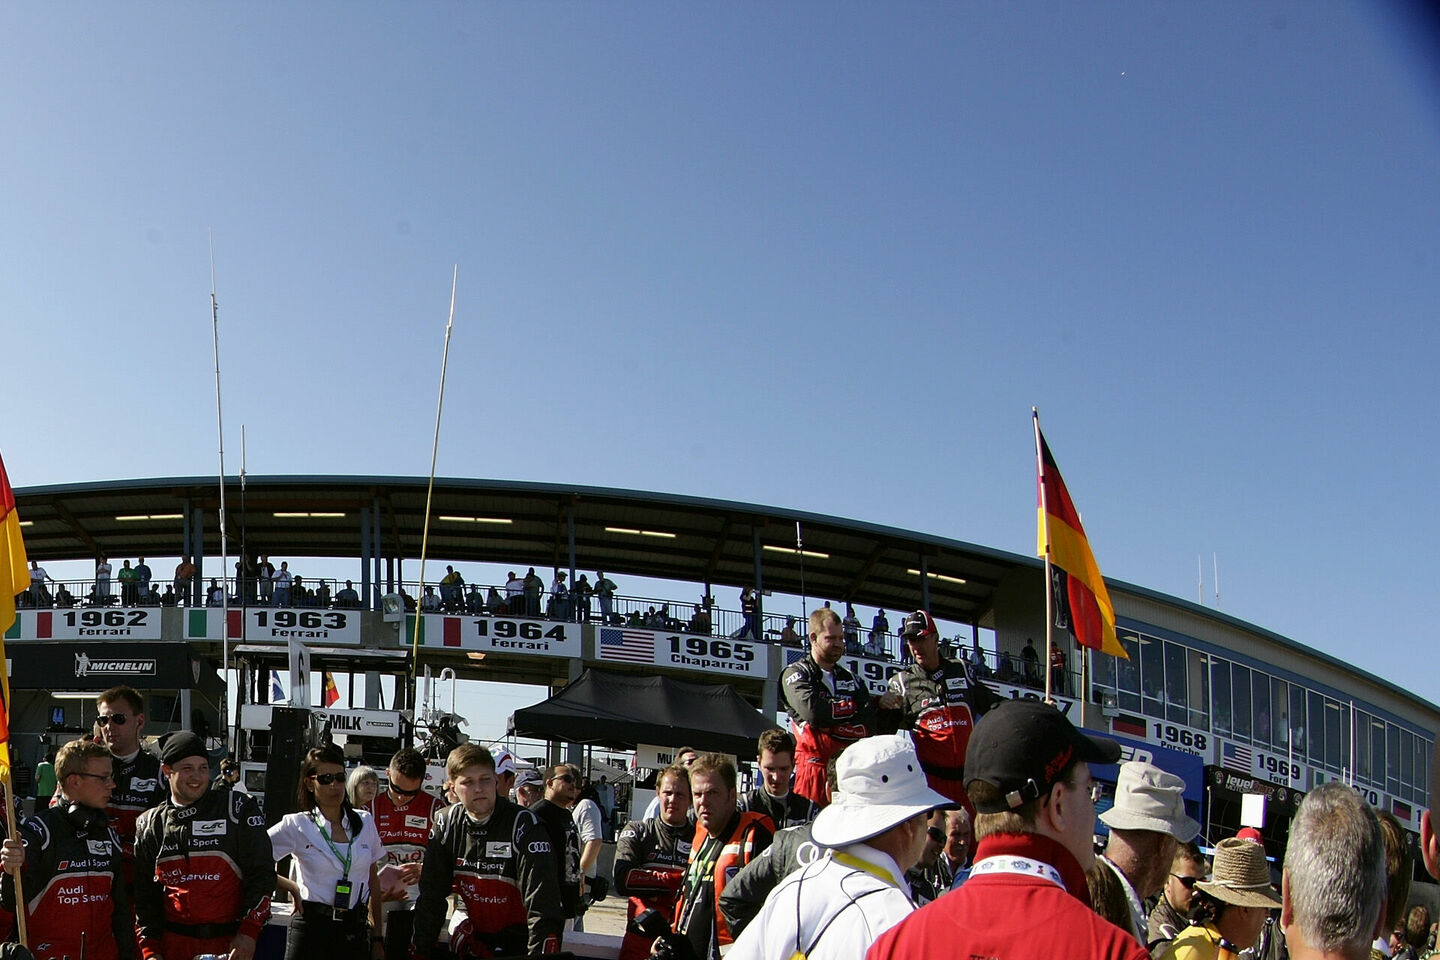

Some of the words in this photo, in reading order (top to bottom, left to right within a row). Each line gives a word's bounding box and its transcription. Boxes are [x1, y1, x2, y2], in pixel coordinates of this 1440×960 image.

[63, 610, 147, 627] 1962
[253, 610, 347, 629] 1963
[78, 627, 131, 636] Ferrari
[271, 628, 329, 639] Ferrari
[473, 619, 567, 642] 1964
[491, 638, 549, 650] Ferrari
[666, 636, 754, 662] 1965
[91, 661, 154, 672] MICHELIN
[670, 653, 750, 672] Chaparral
[329, 714, 362, 731] MILK
[1153, 722, 1207, 751] 1968
[1257, 752, 1301, 781] 1969
[1269, 773, 1289, 787] Ford
[386, 830, 404, 838] Audi
[404, 830, 423, 839] Sport
[192, 837, 219, 849] Sport
[69, 859, 91, 868] Audi
[463, 860, 481, 869] Audi
[481, 861, 505, 871] Sport
[57, 885, 84, 896] Audi
[57, 895, 78, 905] Top
